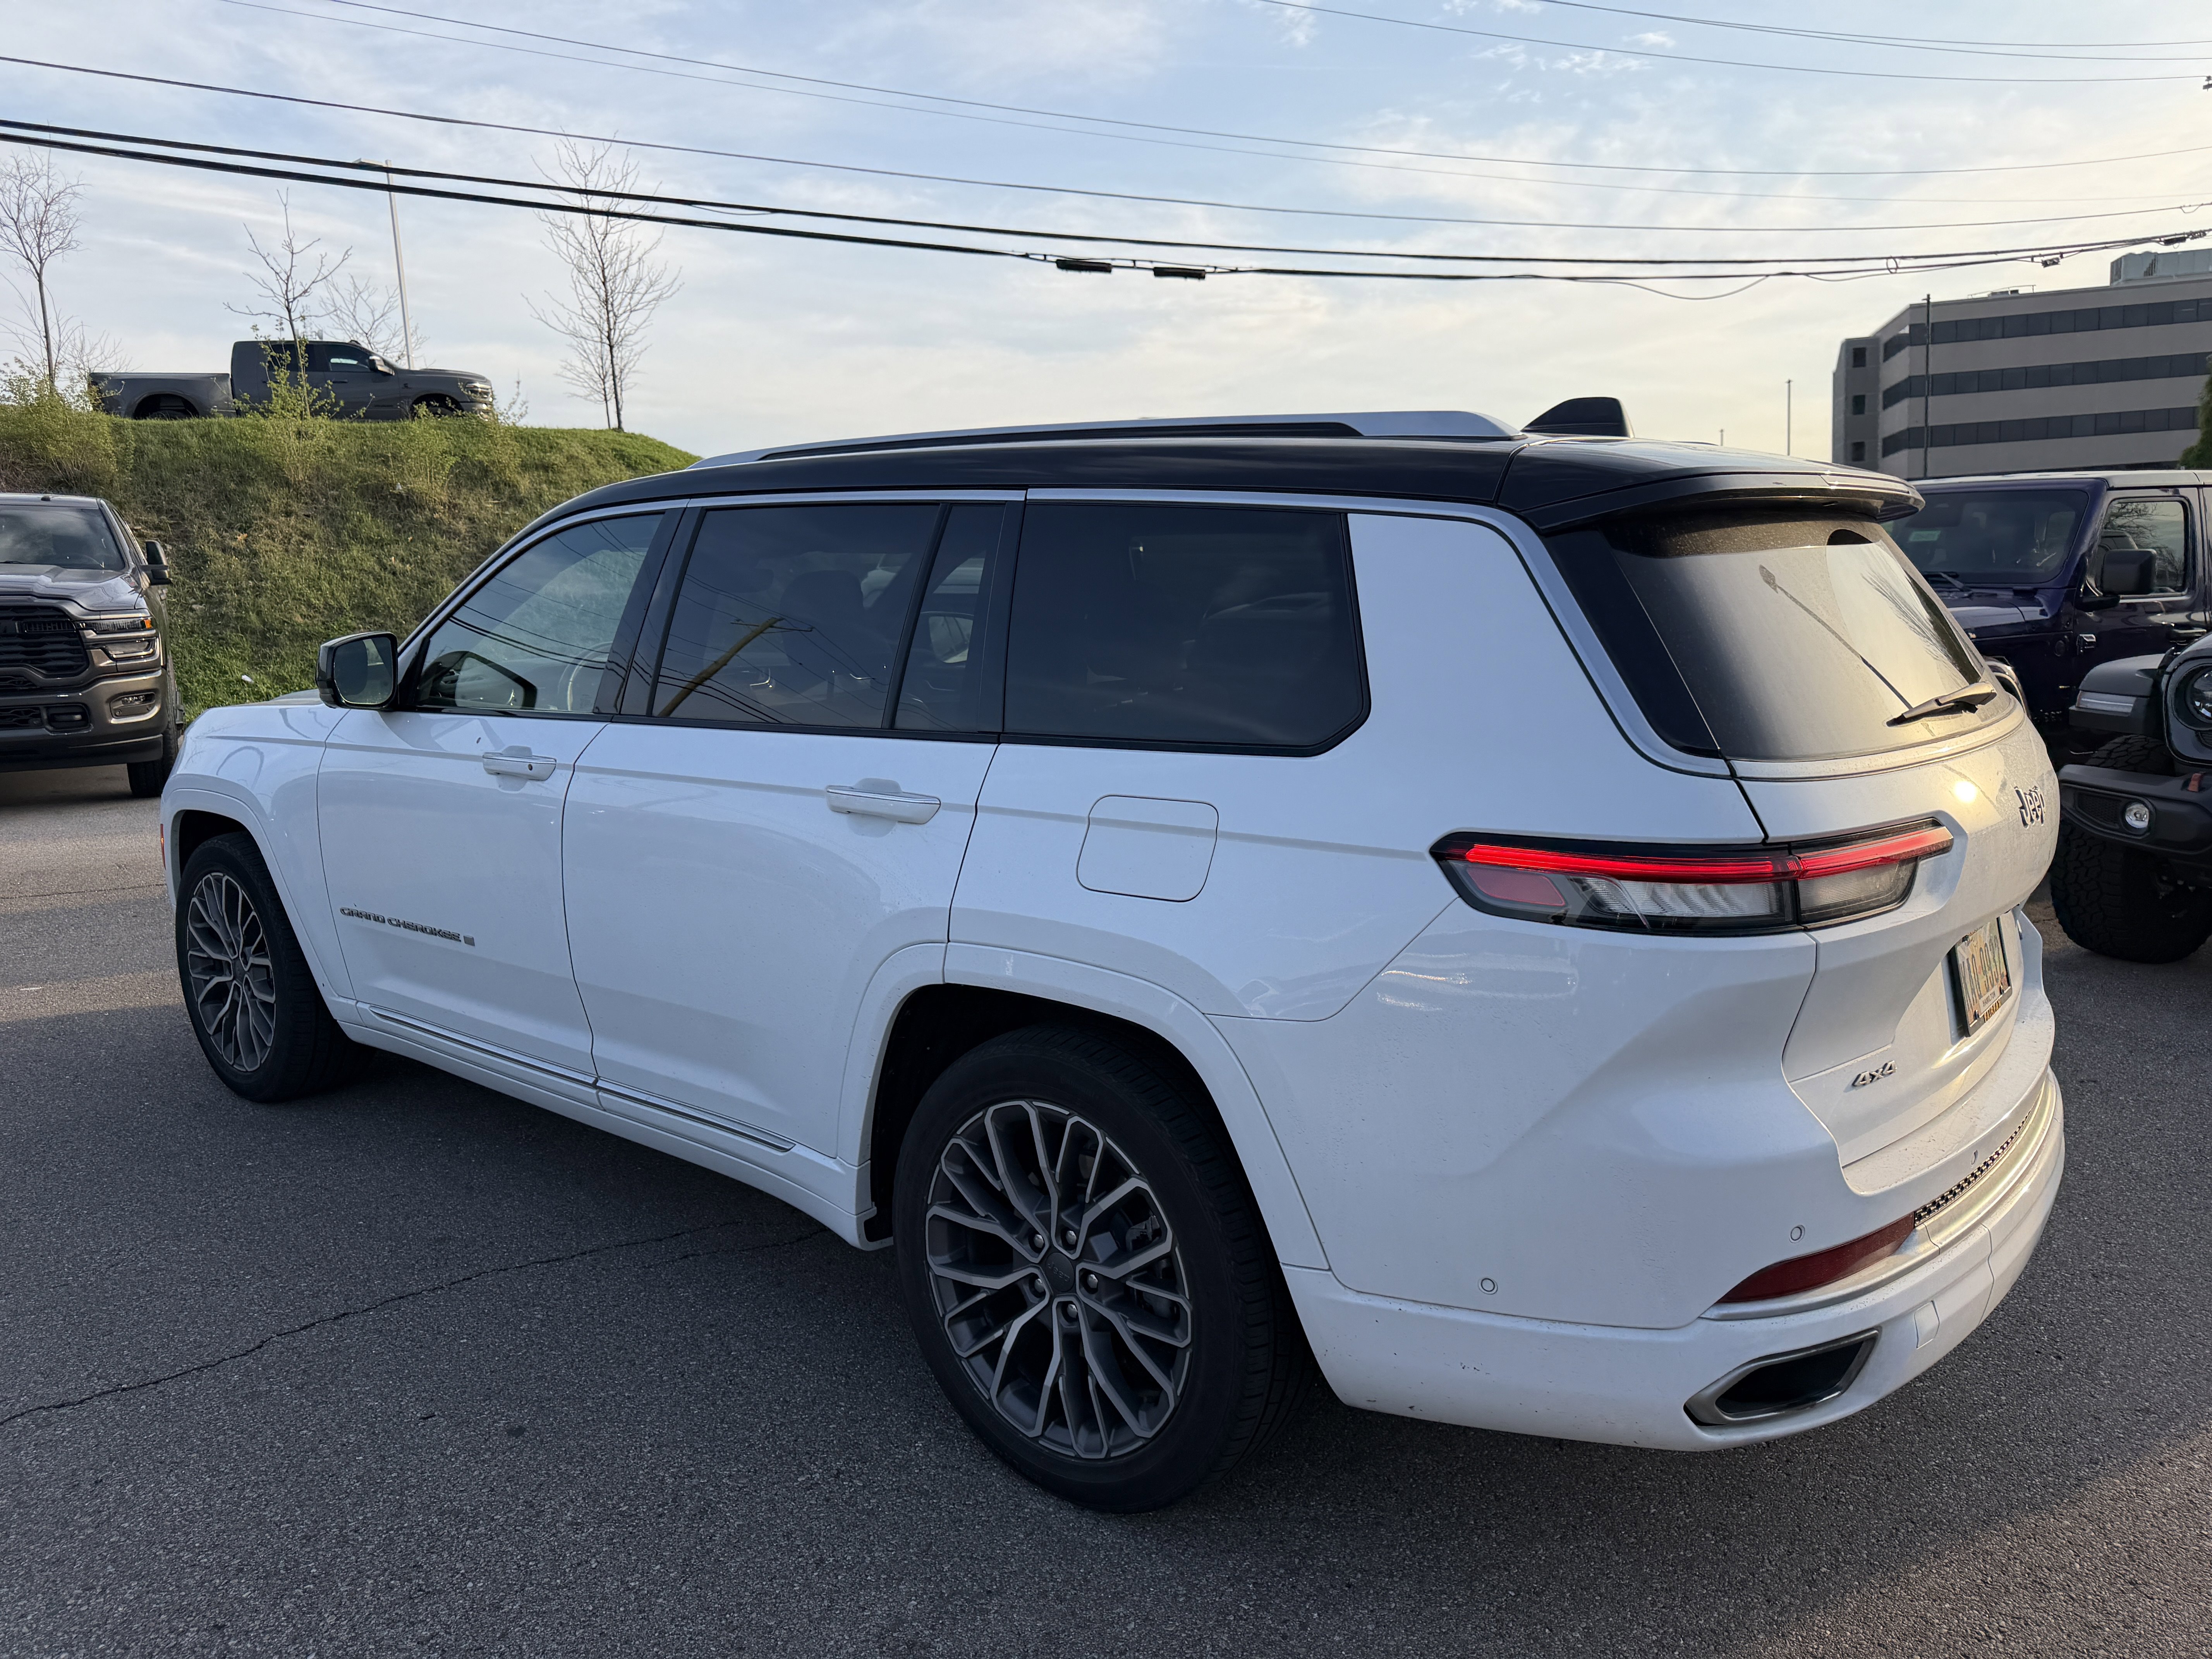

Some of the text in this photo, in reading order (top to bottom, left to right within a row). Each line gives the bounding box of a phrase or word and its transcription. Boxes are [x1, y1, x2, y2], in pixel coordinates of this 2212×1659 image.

[2014, 786, 2045, 830] Jeep
[340, 907, 385, 924] GRAND
[387, 917, 462, 943] CHEROKEE
